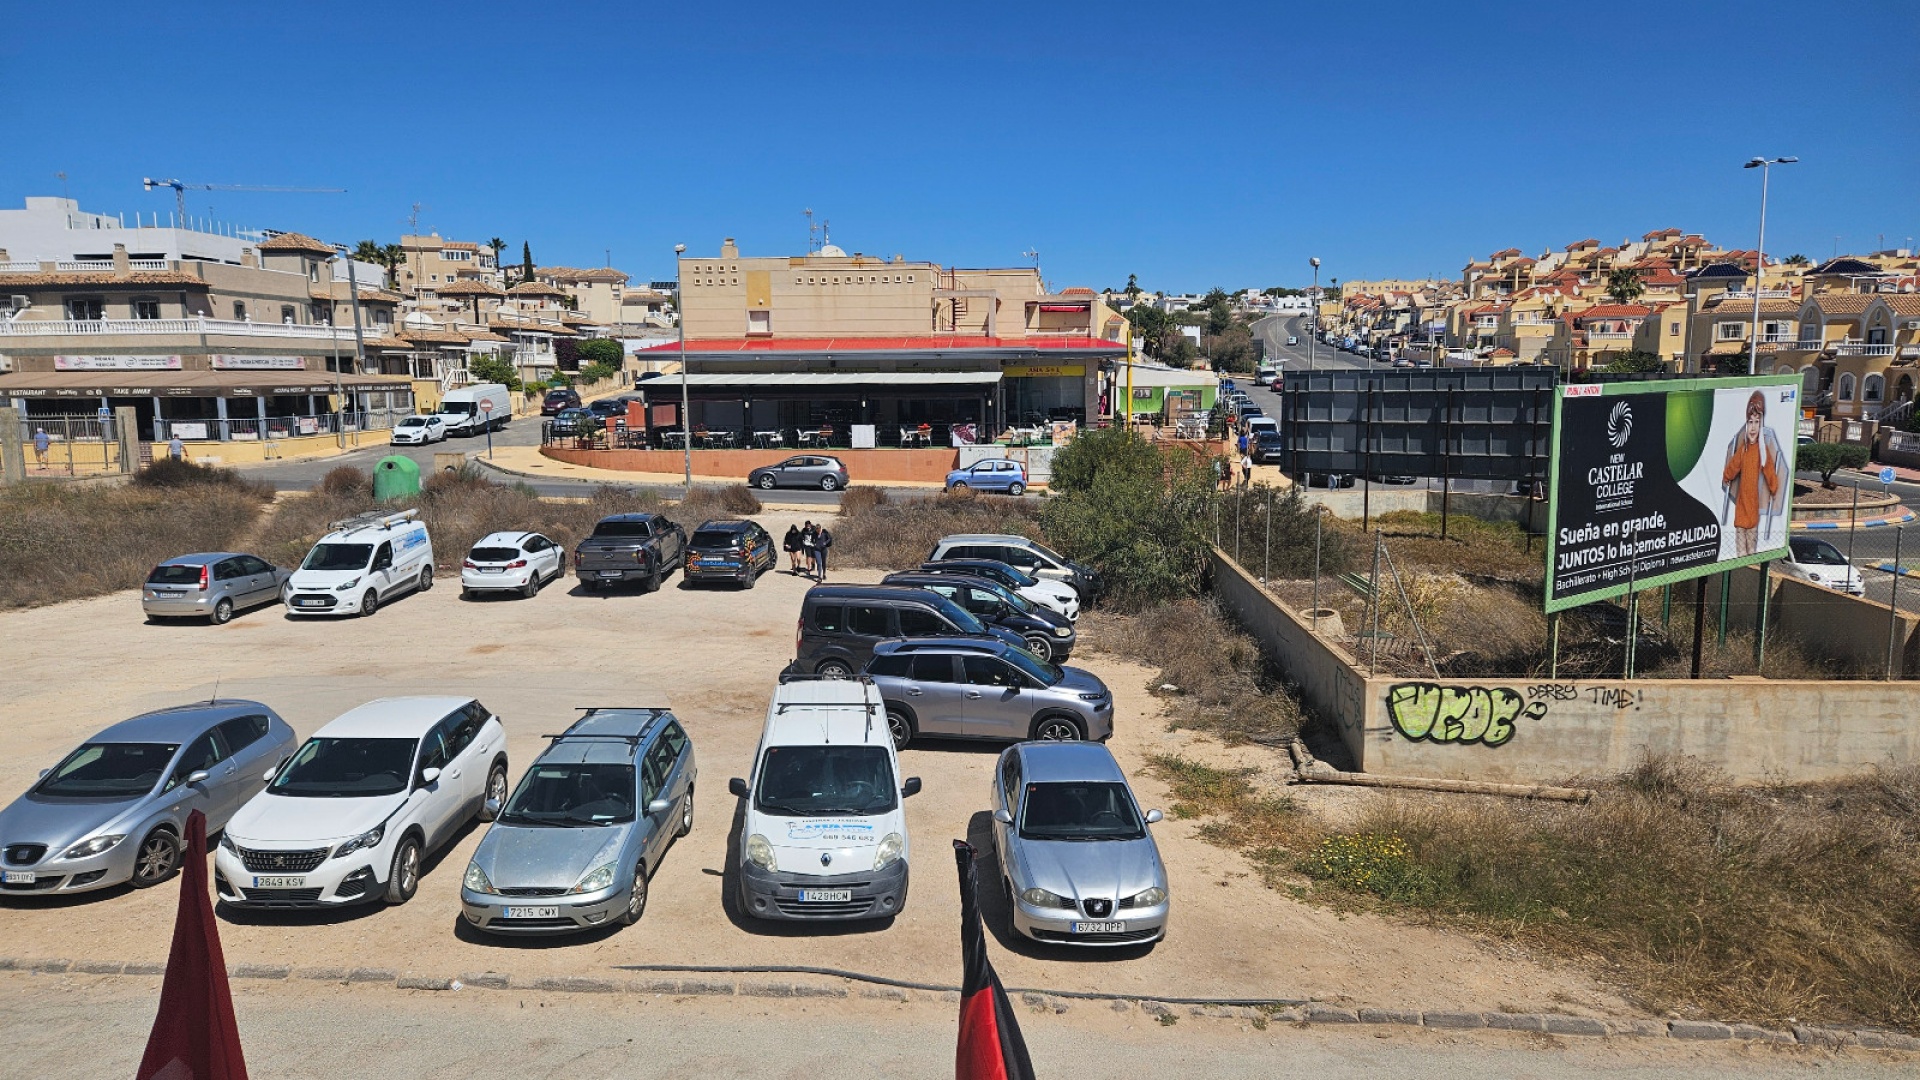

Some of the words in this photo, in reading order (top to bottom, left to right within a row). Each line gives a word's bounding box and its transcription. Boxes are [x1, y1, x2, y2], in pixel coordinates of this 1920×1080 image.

[1609, 453, 1625, 464] NEW
[1588, 461, 1644, 486] CASTELAR
[1596, 481, 1635, 499] COLLEGE
[1559, 522, 1600, 546] Sueña
[1603, 525, 1620, 537] en
[1622, 510, 1667, 539] grande,
[1557, 545, 1605, 571] JUNTOS
[1607, 543, 1617, 560] lo
[1668, 523, 1718, 547] REALIDAD
[1555, 572, 1597, 591] Bachillerato
[1602, 567, 1618, 582] High
[1640, 557, 1665, 573] Diploma
[1669, 548, 1717, 565] newcastelar.com
[1528, 683, 1578, 701] DERBY
[1585, 686, 1644, 711] TIME!
[259, 877, 283, 887] 2649
[510, 907, 534, 918] 7215
[1078, 922, 1102, 932] 6732
